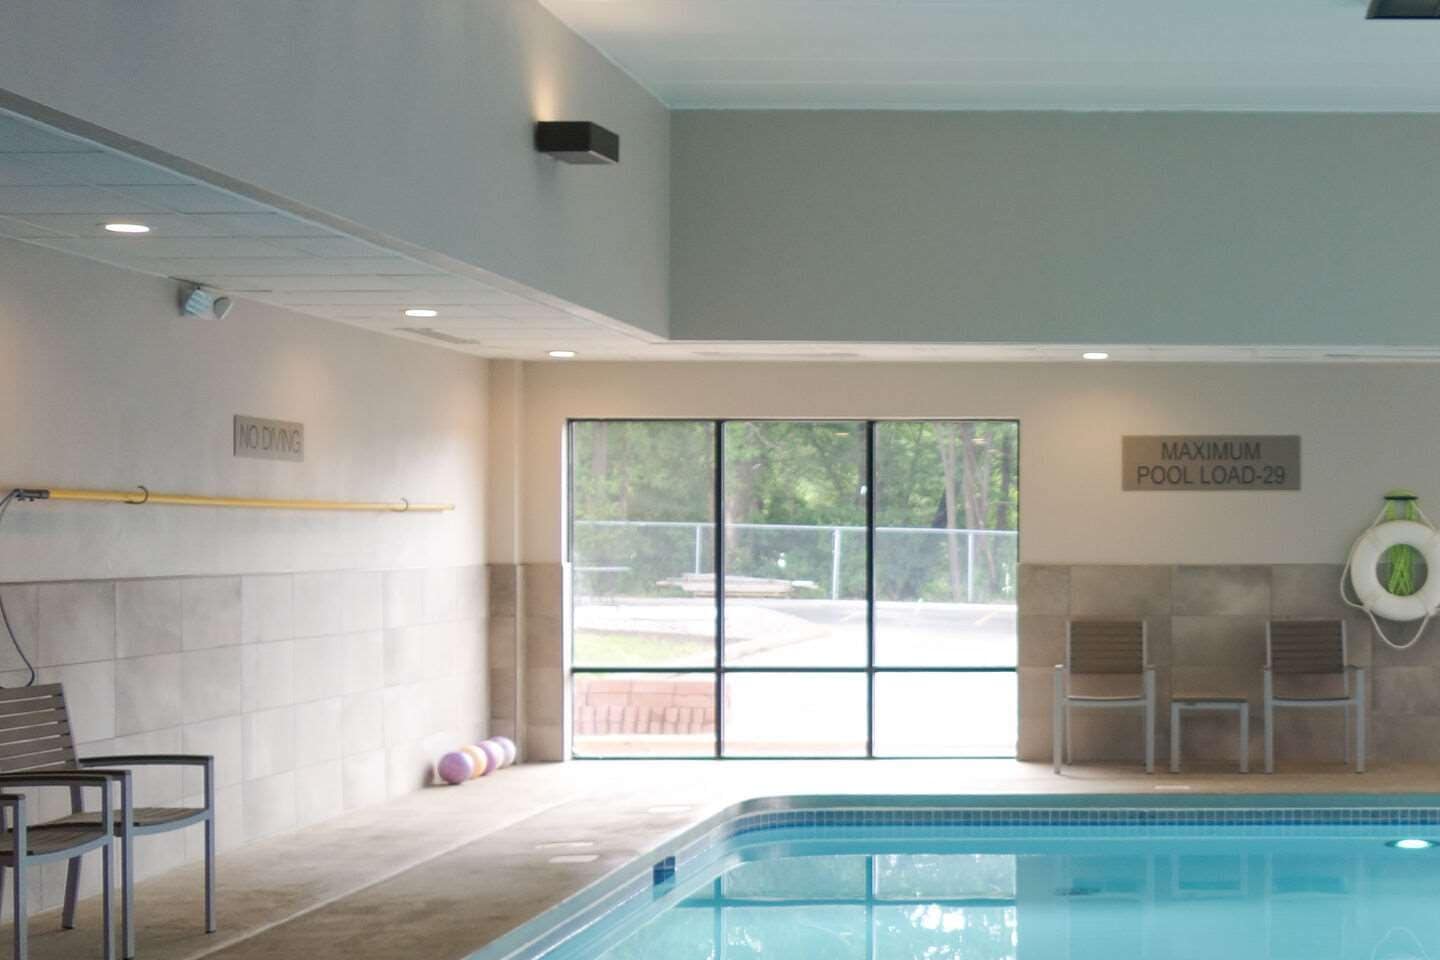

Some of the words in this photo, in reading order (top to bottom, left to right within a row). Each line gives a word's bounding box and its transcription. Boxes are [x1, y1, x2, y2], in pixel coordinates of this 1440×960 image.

[239, 423, 259, 449] NO
[261, 425, 302, 454] DIVING
[1161, 442, 1261, 460] MAXIMUM
[1136, 465, 1193, 485] POOL
[1200, 465, 1286, 485] LOAD-29
